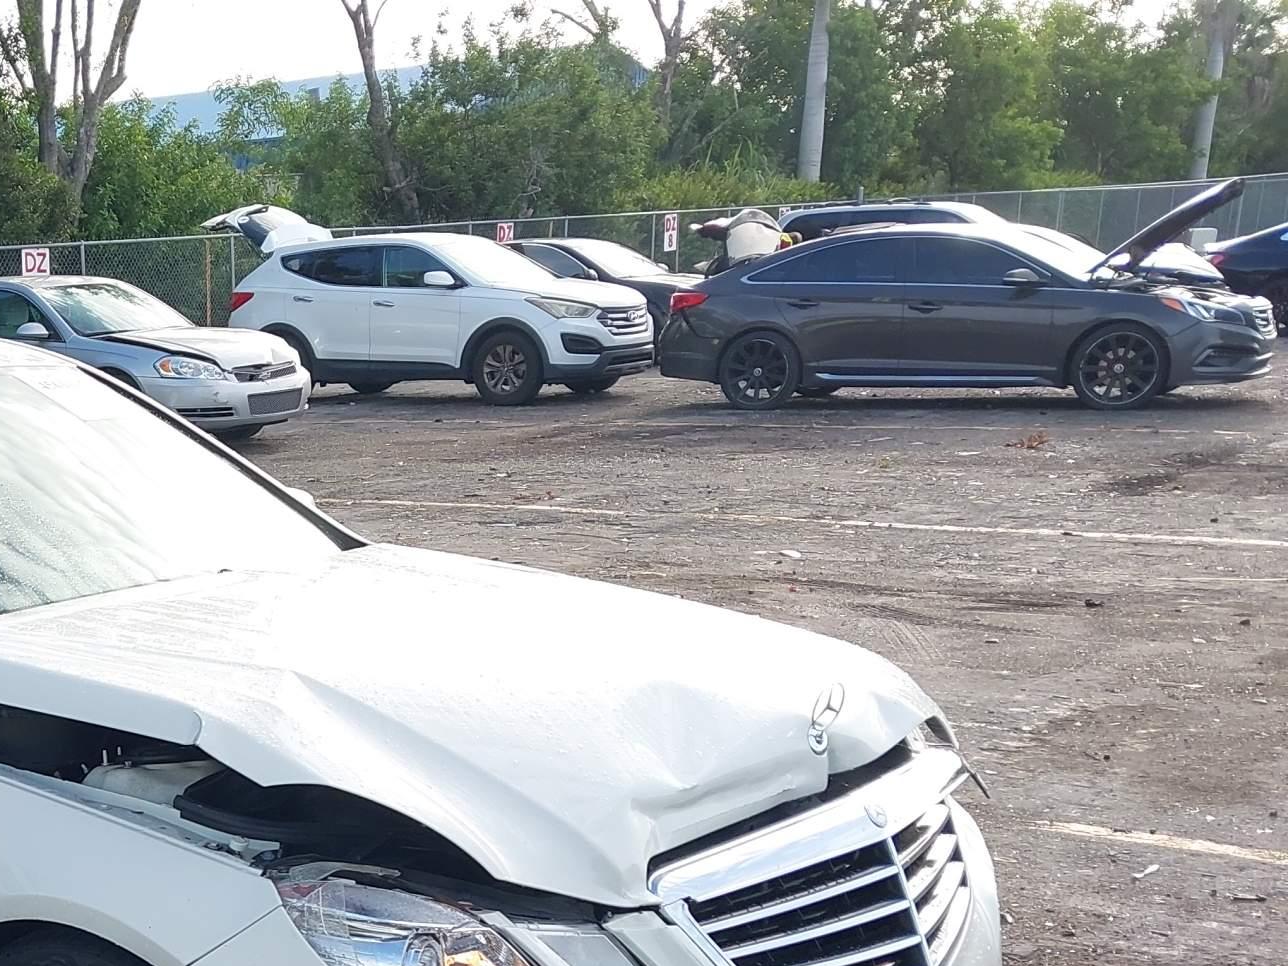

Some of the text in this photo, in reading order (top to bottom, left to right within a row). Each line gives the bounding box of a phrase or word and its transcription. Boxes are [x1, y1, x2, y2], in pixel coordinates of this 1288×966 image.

[665, 214, 677, 232] DZ
[499, 225, 513, 242] DZ
[24, 251, 47, 273] DZ
